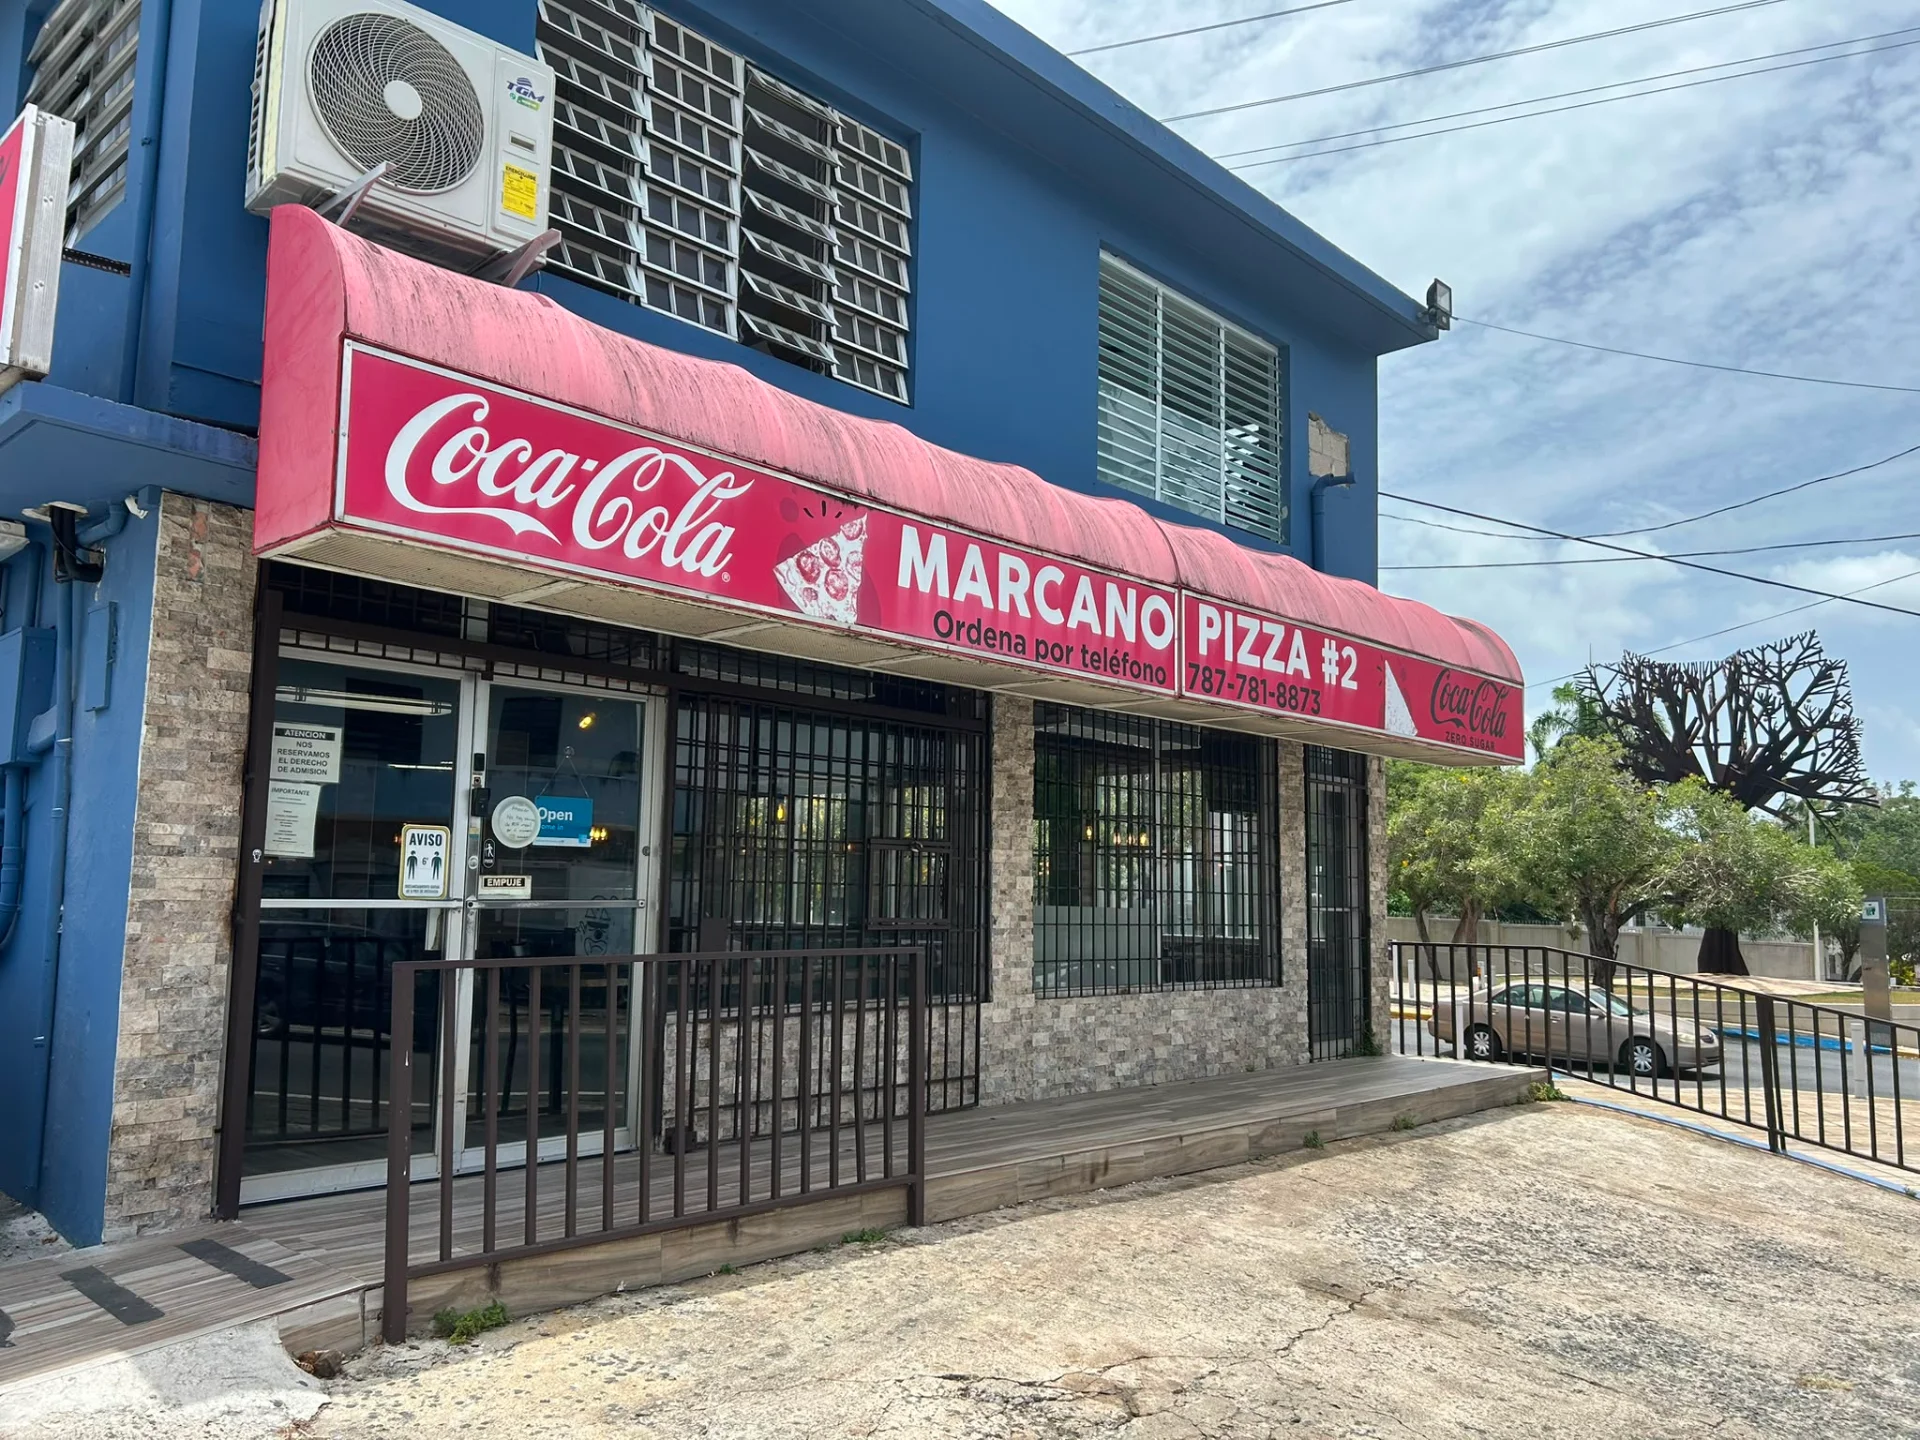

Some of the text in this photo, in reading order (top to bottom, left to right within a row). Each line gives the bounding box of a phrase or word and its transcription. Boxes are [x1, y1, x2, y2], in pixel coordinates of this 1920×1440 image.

[506, 80, 545, 103] TGM
[385, 393, 754, 578] Coca-Cola
[897, 524, 1358, 690] MARCANO PIZZA #2
[933, 609, 1321, 715] Ordena por teléfono 787-781-8873
[1430, 668, 1509, 738] Coca-Cola
[284, 729, 326, 739] ATENCION
[1445, 731, 1496, 752] ZERO SUGAR
[296, 741, 313, 749] NOS
[277, 748, 330, 759] RESERVAMOS
[290, 757, 328, 767] DERECHO
[277, 765, 328, 776] DE ADMISION
[271, 787, 310, 797] IMPORTANTE
[538, 806, 573, 823] Open
[409, 832, 443, 847] AVISO
[486, 878, 522, 887] EMPUJE
